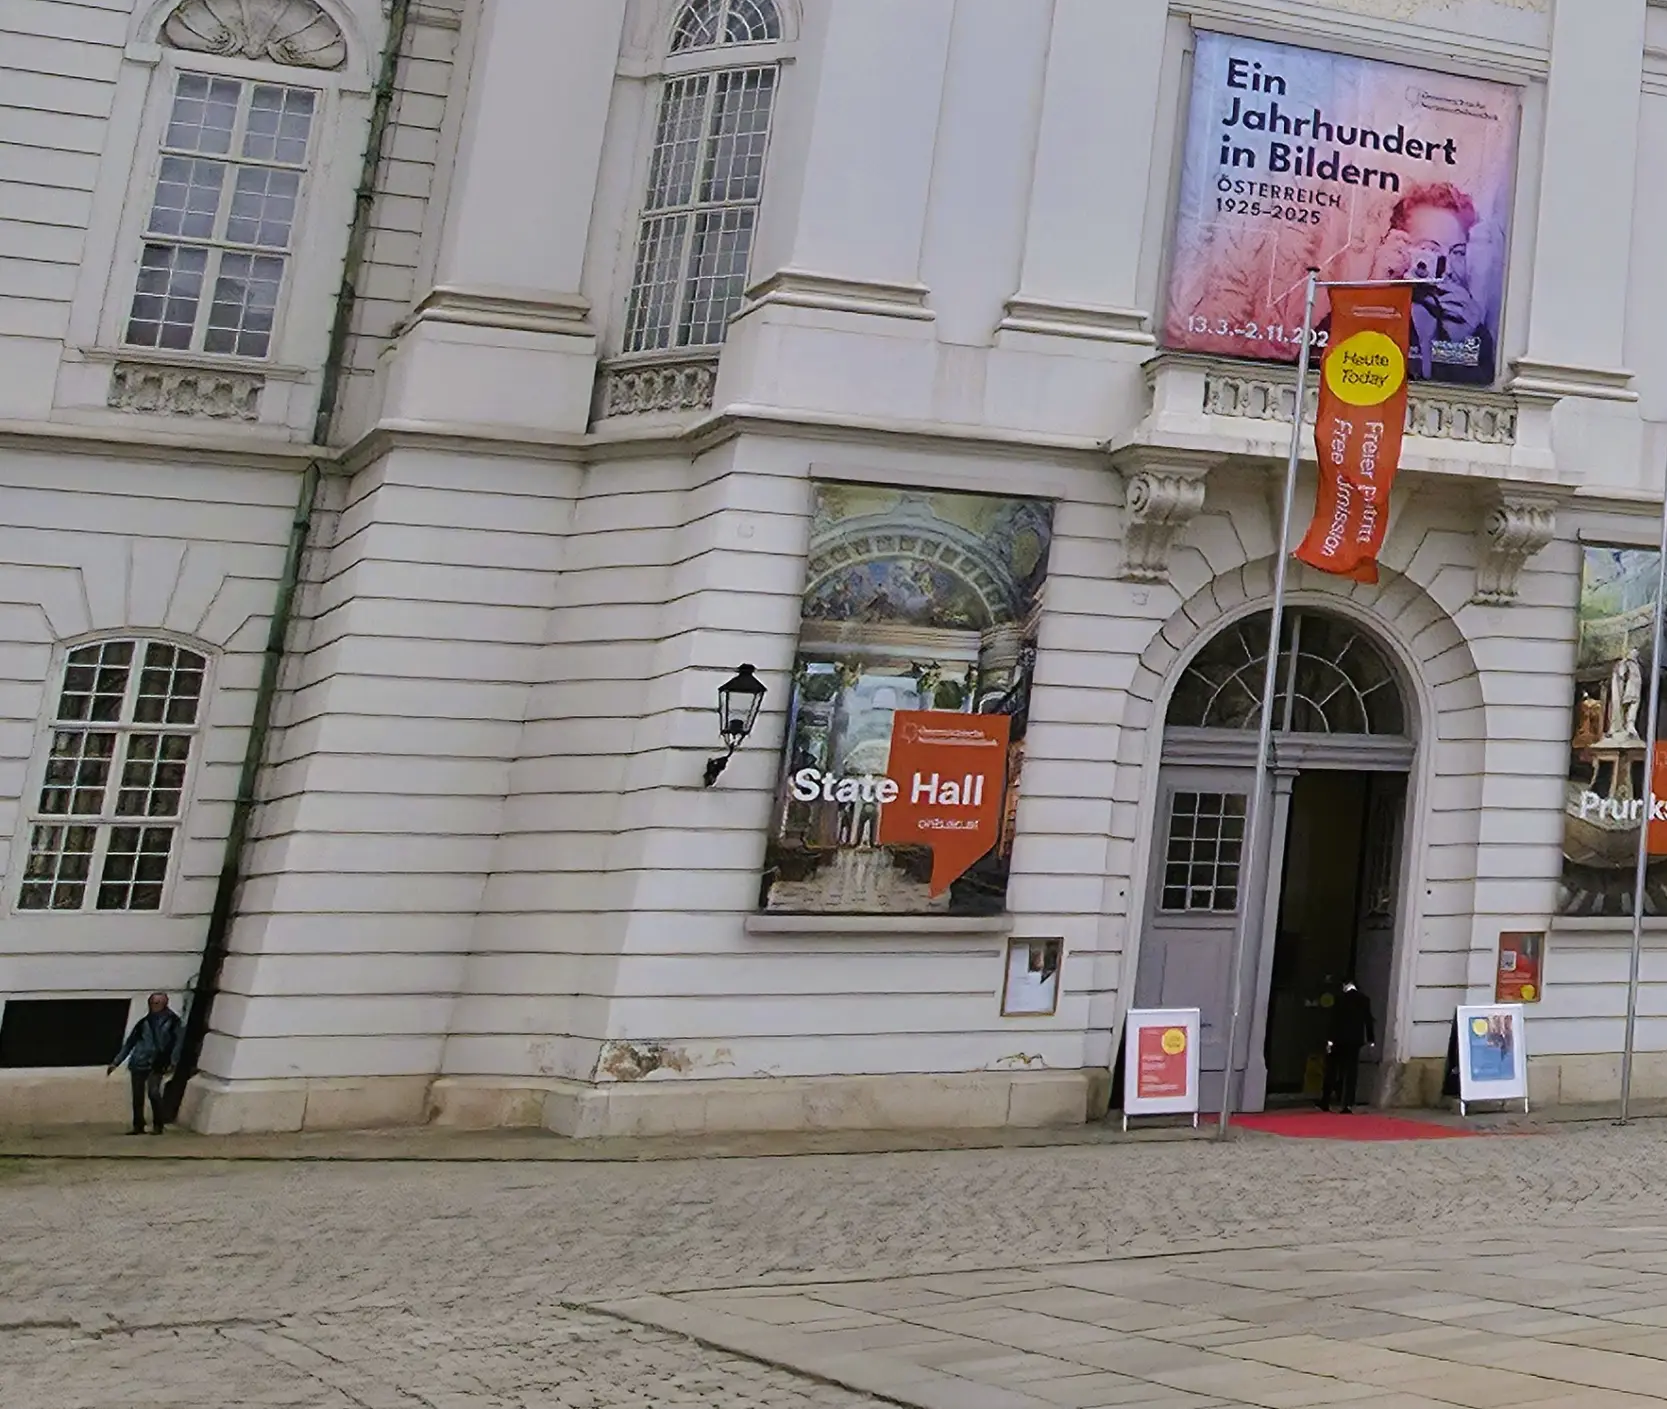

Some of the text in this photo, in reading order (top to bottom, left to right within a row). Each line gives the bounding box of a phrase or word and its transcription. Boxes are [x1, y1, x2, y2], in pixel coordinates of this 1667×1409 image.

[1227, 57, 1286, 96] Ein
[1222, 97, 1457, 165] Jahrhundert
[1219, 134, 1400, 193] in Bildern
[1217, 175, 1341, 208] ÖSTERREICH
[1342, 351, 1389, 366] Heute
[1342, 368, 1389, 388] Today
[1331, 417, 1353, 465] Free
[1360, 421, 1384, 480] Freier
[792, 767, 985, 807] State Hall
